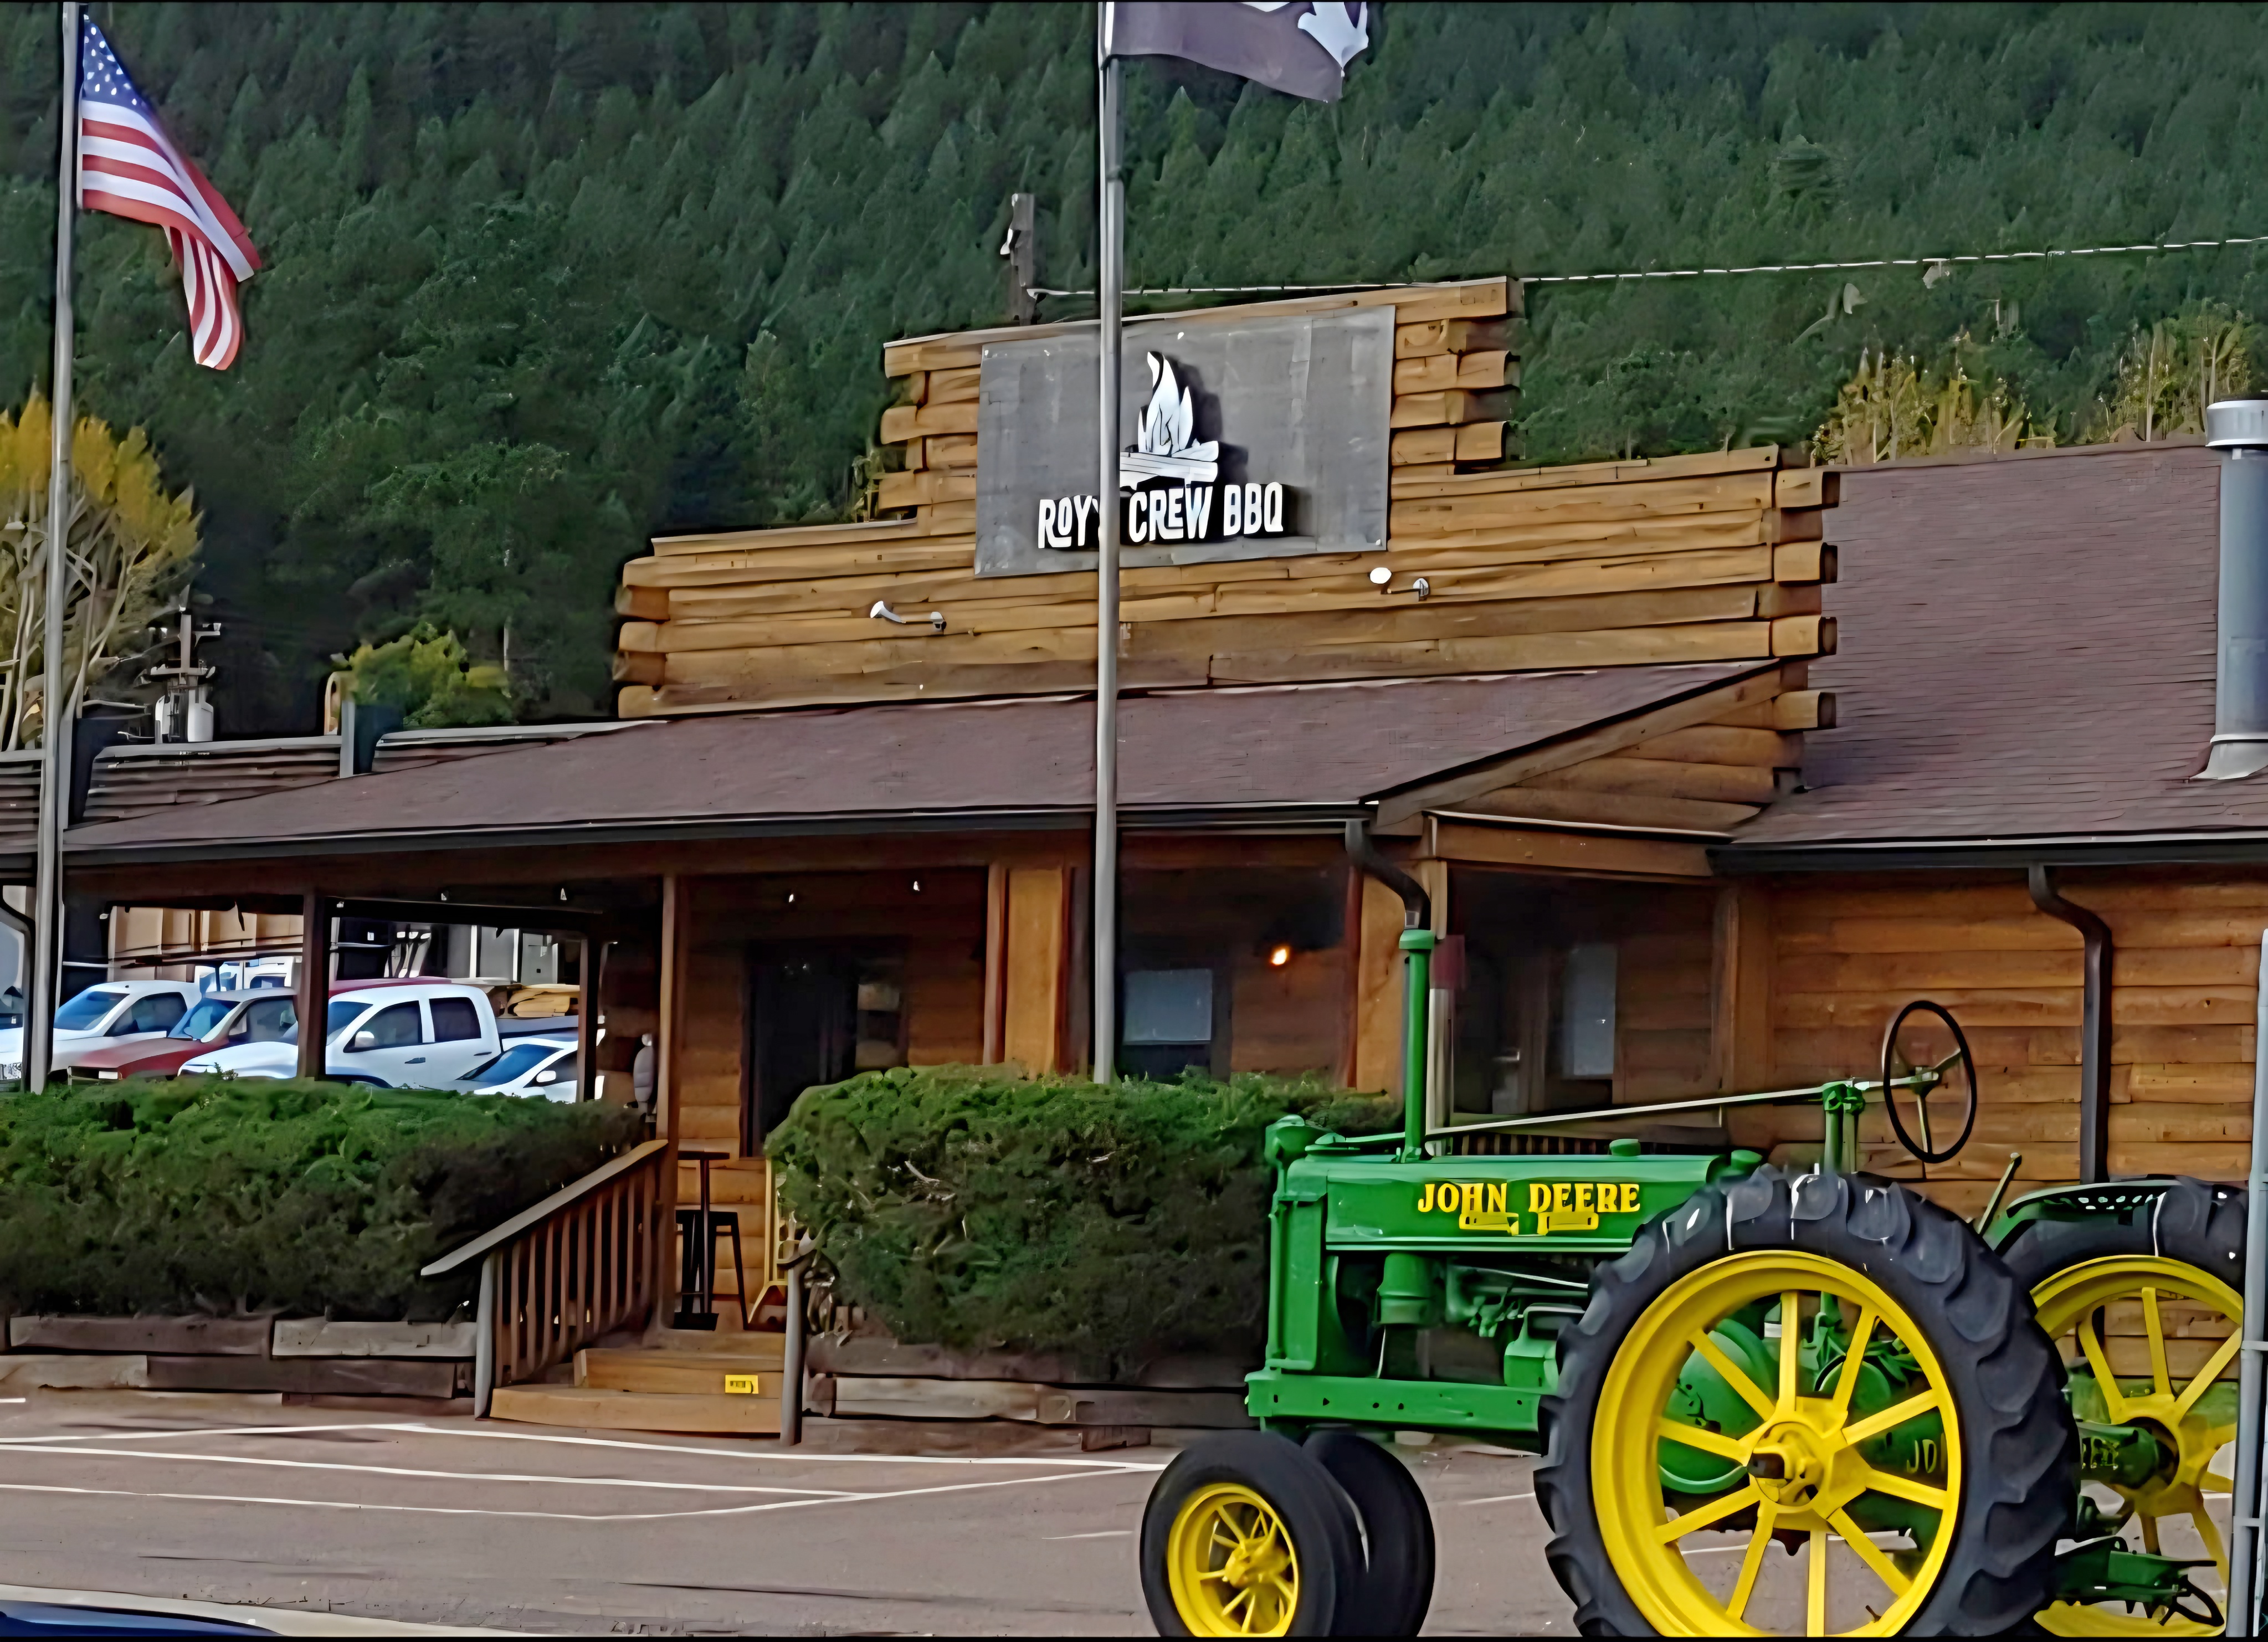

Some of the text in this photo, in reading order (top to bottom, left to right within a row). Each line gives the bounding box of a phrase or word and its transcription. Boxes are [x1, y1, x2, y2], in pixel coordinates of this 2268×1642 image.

[1038, 482, 1284, 548] ROY' CREW BBQ
[1418, 1182, 1640, 1213] JOHN DEERE
